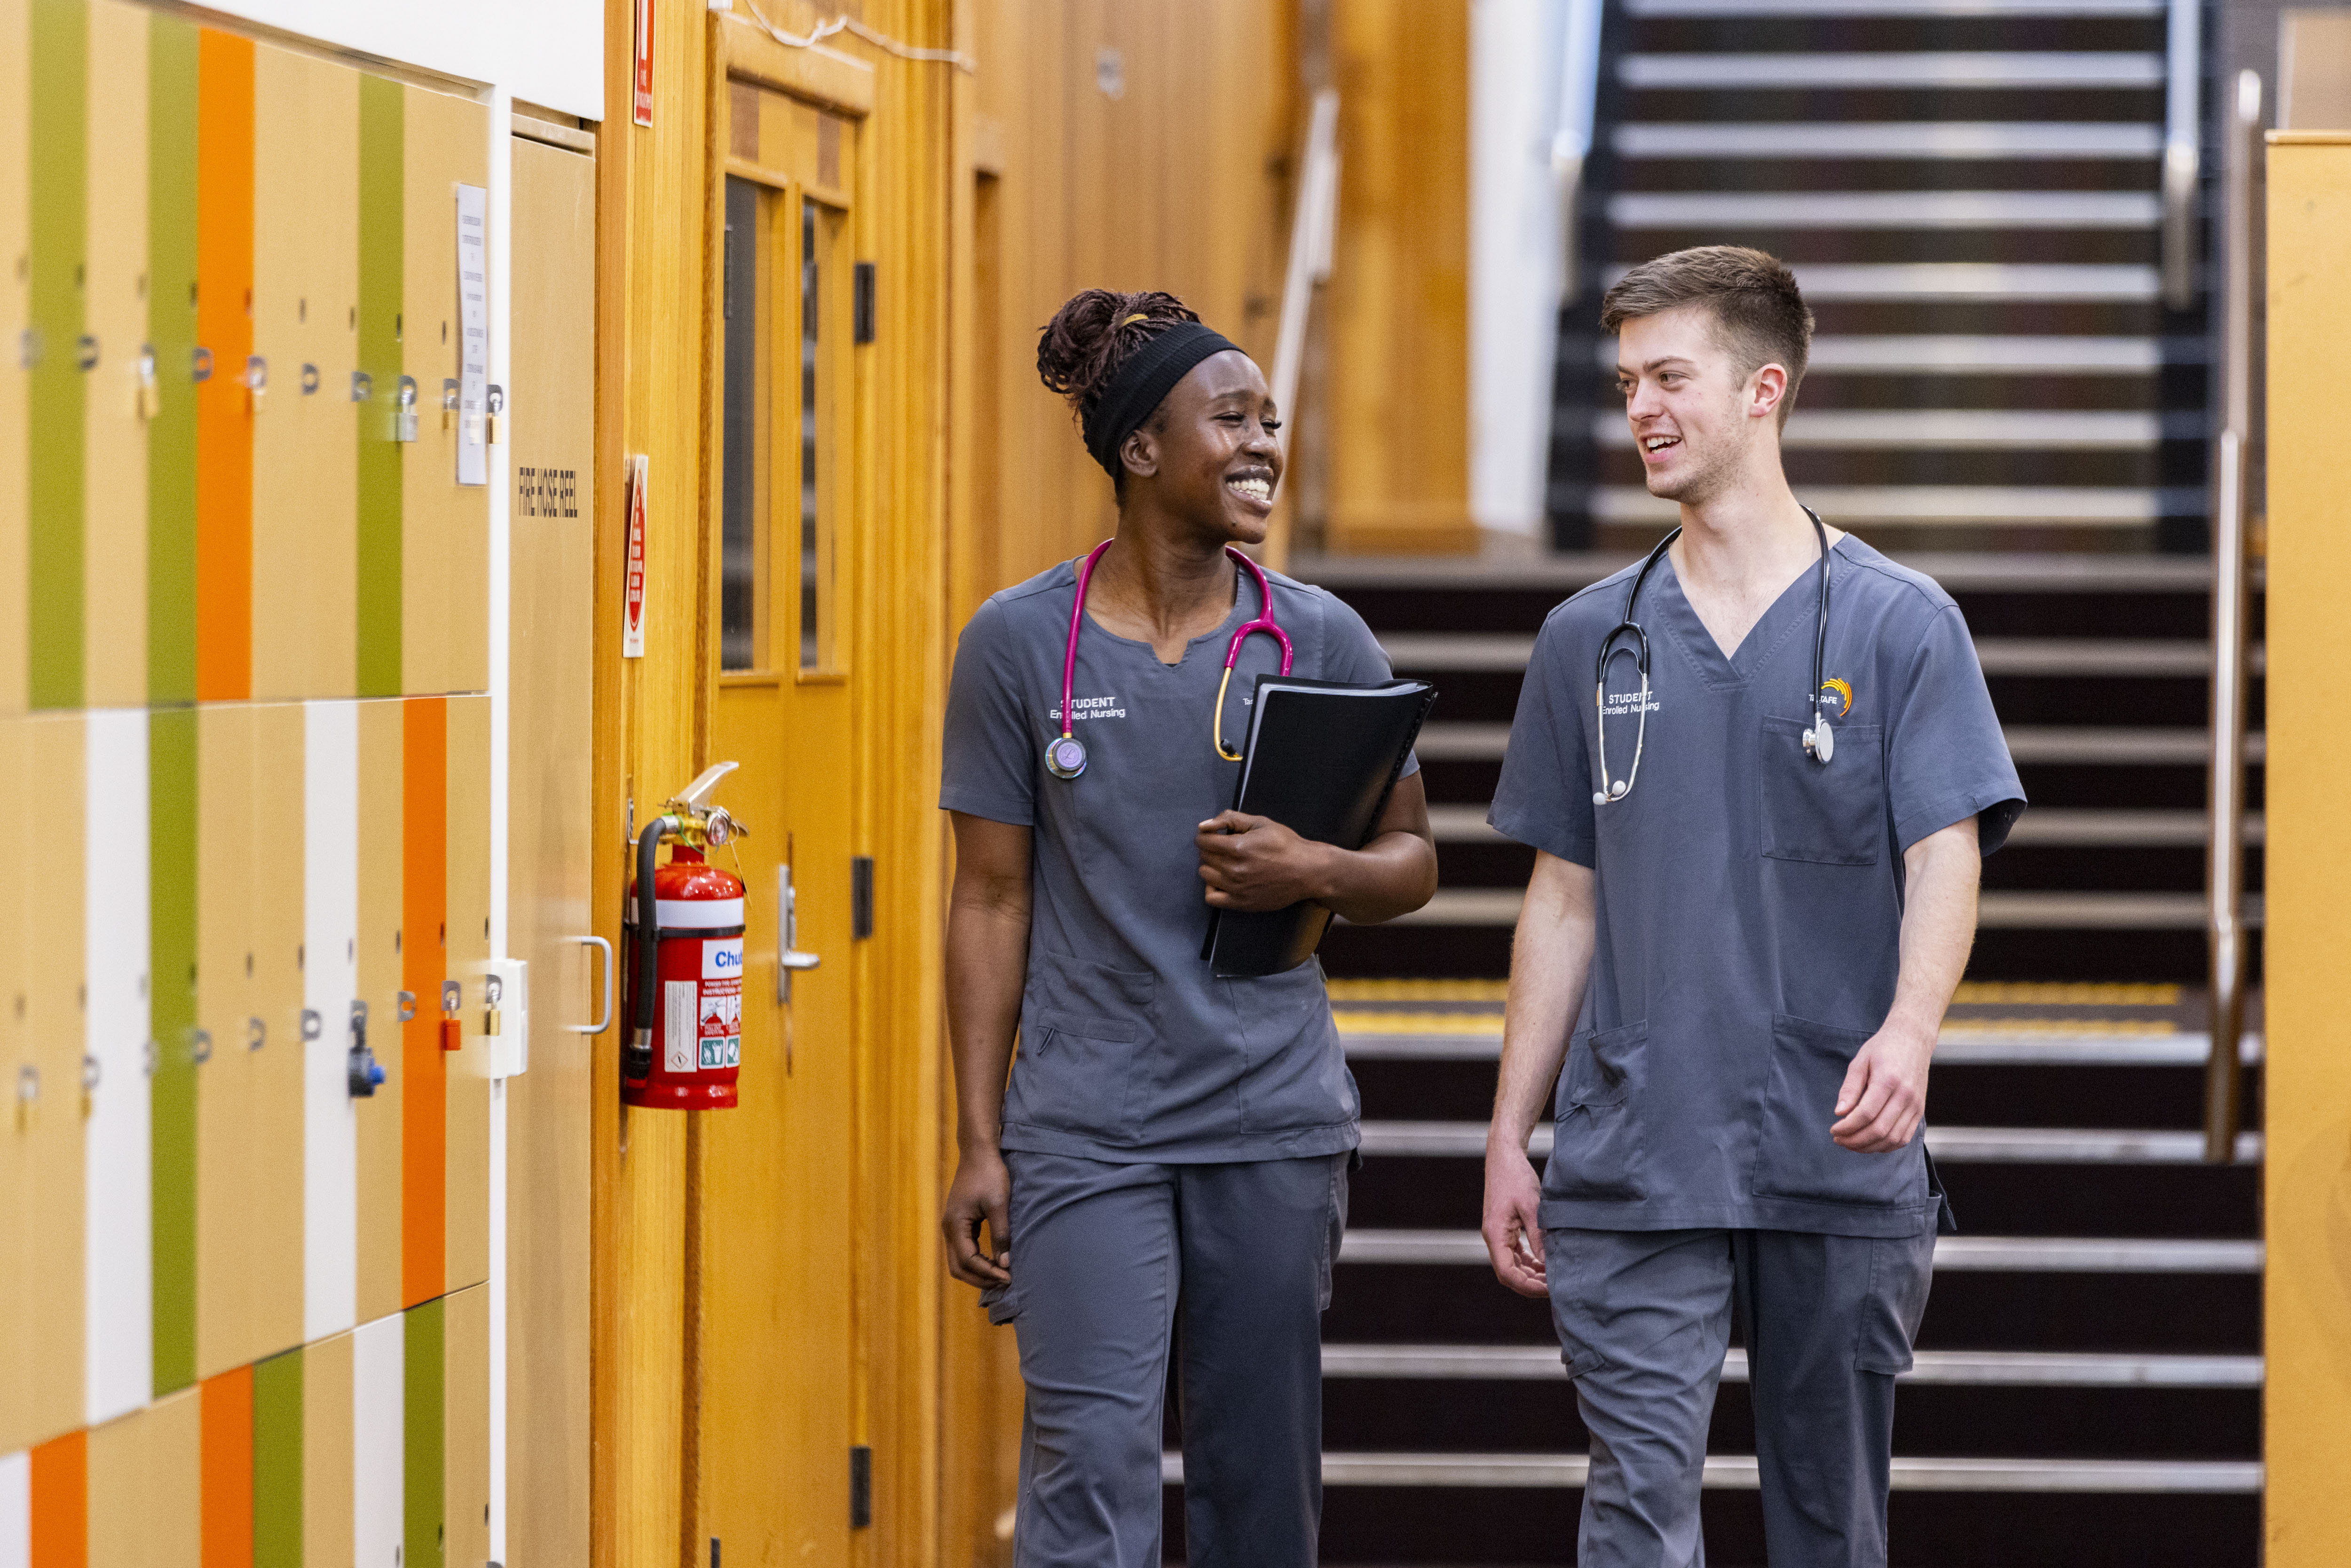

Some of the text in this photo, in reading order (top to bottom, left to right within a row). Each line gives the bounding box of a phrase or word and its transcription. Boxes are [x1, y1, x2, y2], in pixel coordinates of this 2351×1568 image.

[519, 467, 577, 518] FIRE HOSE REEL
[1808, 693, 1838, 705] TaTAFE
[1630, 701, 1660, 713] Nusing
[1049, 708, 1126, 720] Enlled Nursing
[715, 950, 743, 967] Chu
